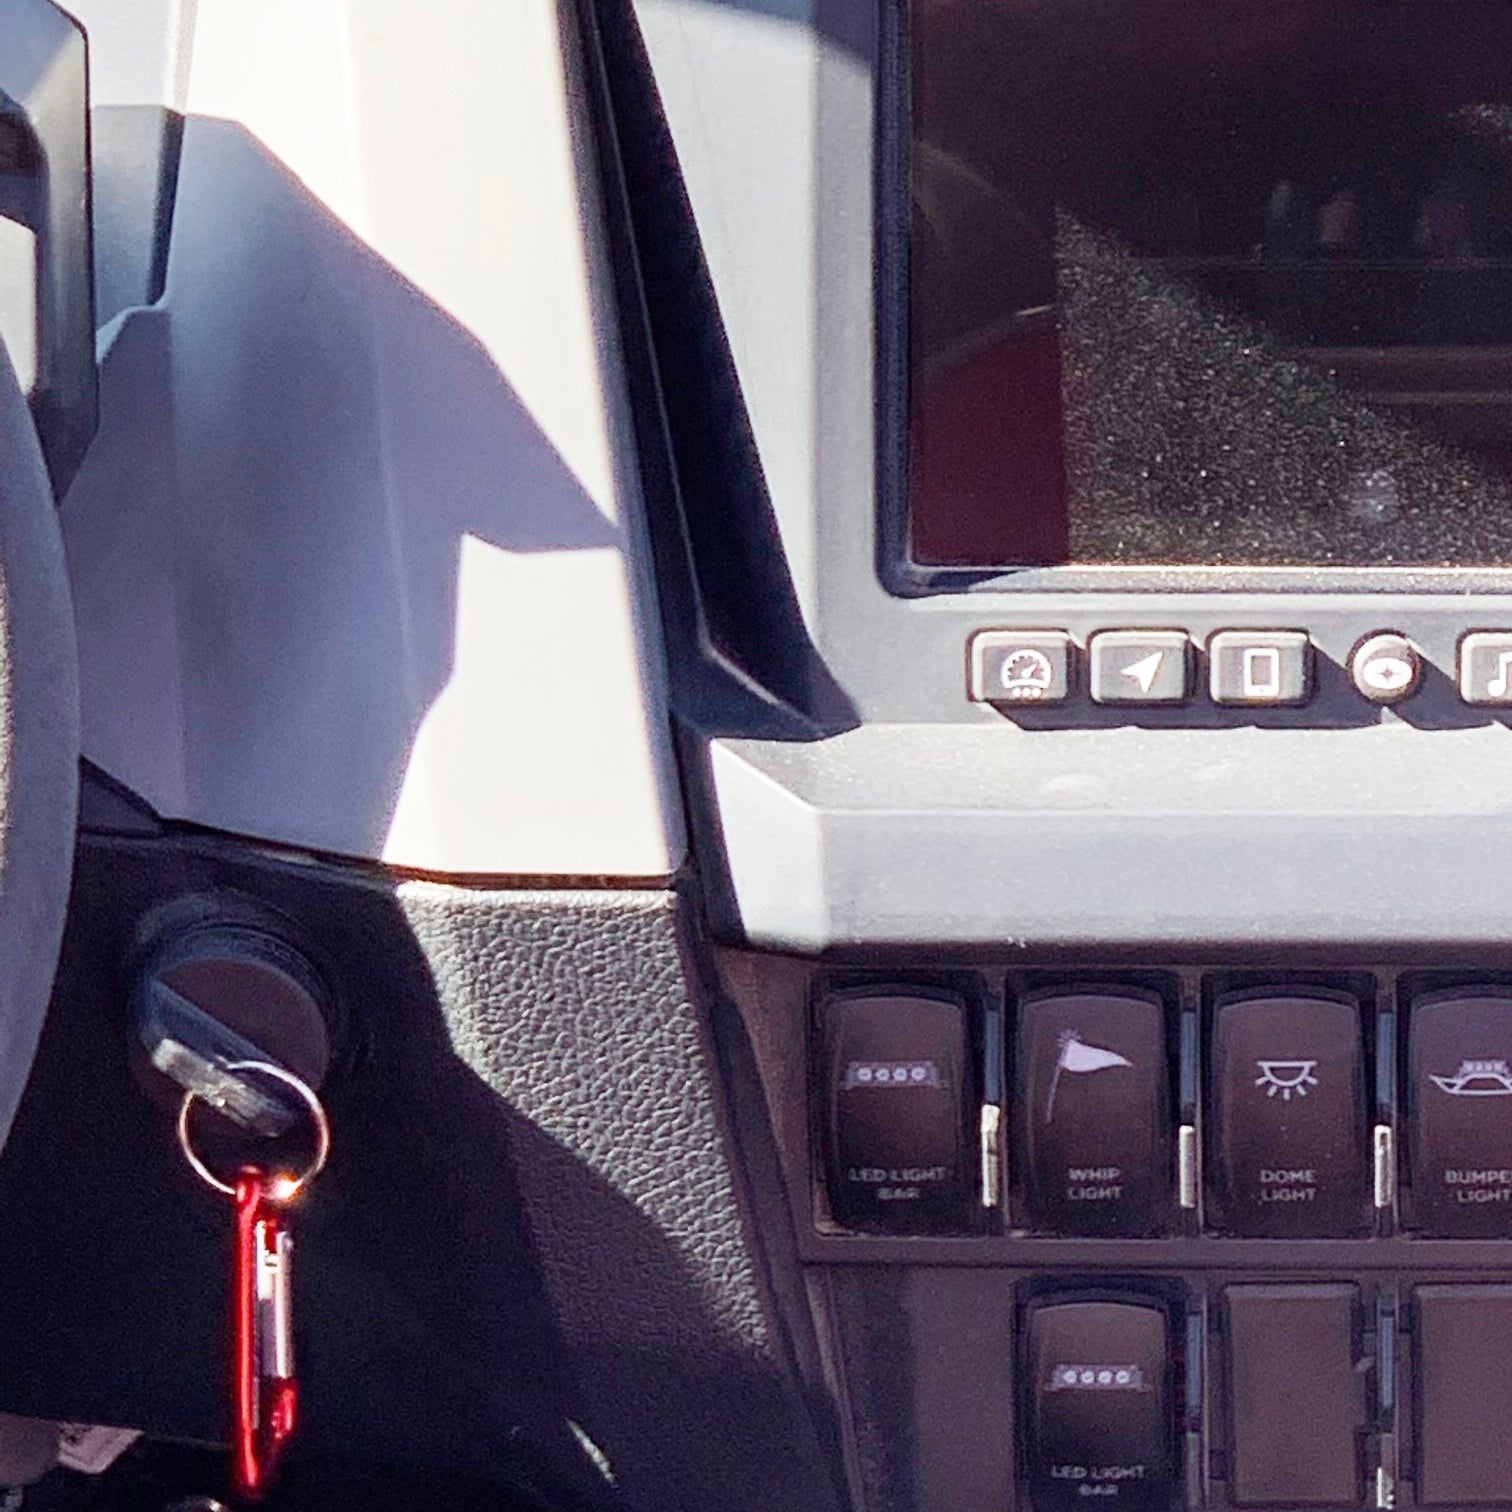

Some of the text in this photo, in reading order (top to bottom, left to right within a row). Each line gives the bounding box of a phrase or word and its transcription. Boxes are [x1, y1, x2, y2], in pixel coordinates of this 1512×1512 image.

[848, 1166, 946, 1182] LED LIGHT
[1068, 1167, 1121, 1181] WHIP
[1260, 1169, 1317, 1183] DOME
[1066, 1186, 1122, 1200] LIGHT
[1261, 1187, 1317, 1202] LIGHT
[1457, 1188, 1512, 1203] LIGHT
[1050, 1464, 1145, 1479] LED LIGHT
